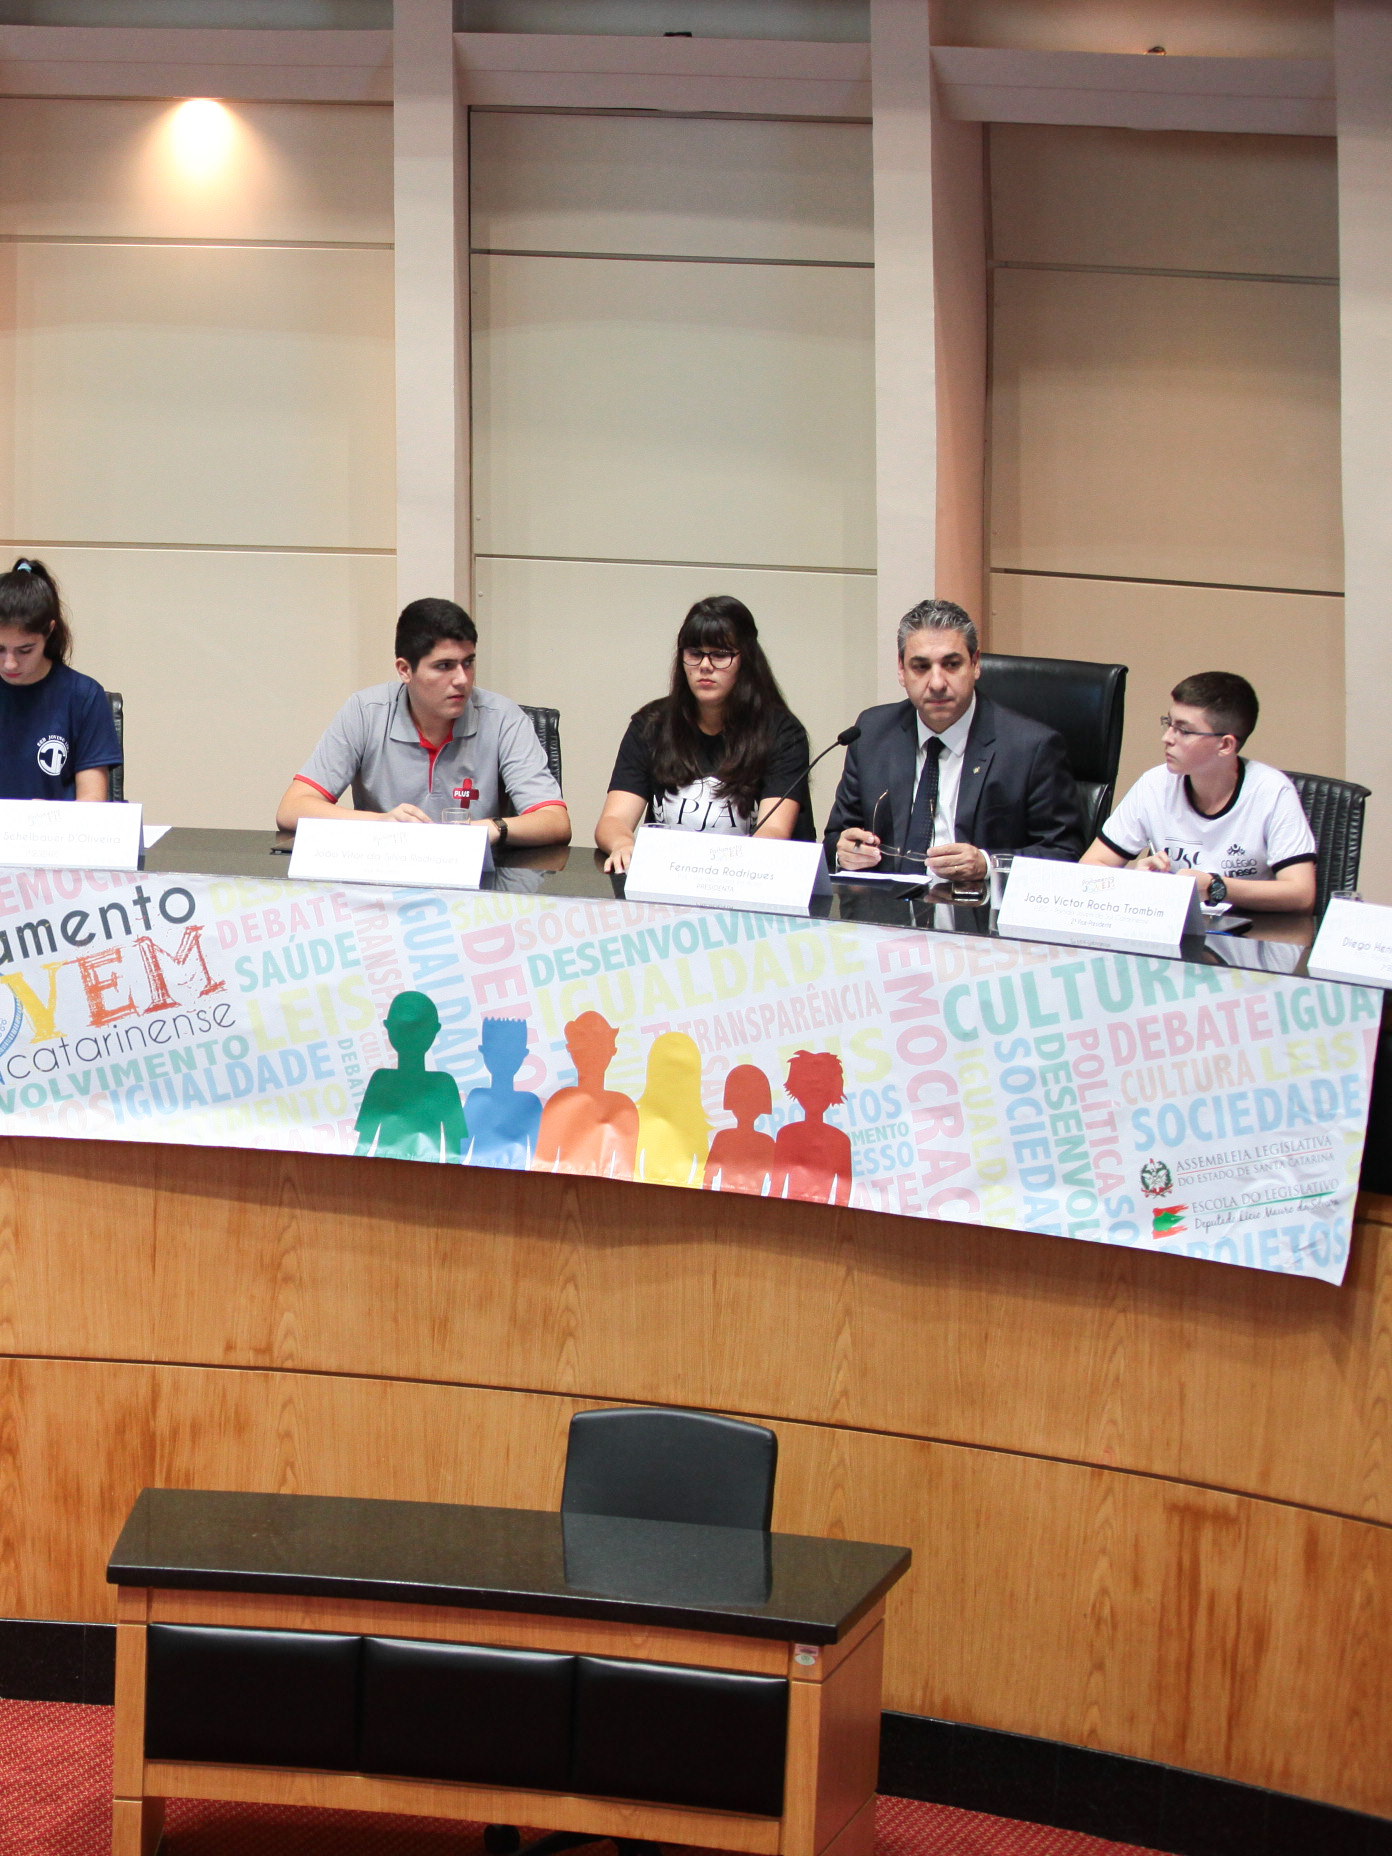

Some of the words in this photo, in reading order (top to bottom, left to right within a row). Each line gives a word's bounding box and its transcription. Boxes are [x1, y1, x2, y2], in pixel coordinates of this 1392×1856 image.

[454, 790, 470, 798] PLUS
[676, 798, 737, 832] PJA
[669, 862, 719, 875] Fernanda
[722, 866, 774, 881] Rodrigues
[696, 883, 734, 892] PRESIDENTA
[215, 891, 352, 950] DEBATE
[1024, 892, 1050, 905] João
[1054, 896, 1083, 909] Victor
[1087, 900, 1119, 913] Rocha
[1124, 904, 1164, 918] Trombim
[235, 931, 362, 993] SAÚDE
[1342, 937, 1371, 951] Diego
[535, 922, 867, 1038] IGUALDADE
[943, 952, 1225, 1042] CULTURA
[245, 975, 376, 1052] LEIS
[678, 980, 883, 1055] TRANSPARÊNCIA
[1107, 993, 1274, 1068] DEBATE
[1274, 983, 1377, 1035] IGUA
[6, 1002, 236, 1080] catarinense
[1258, 1031, 1358, 1082] LEIS
[108, 1040, 337, 1124] IGUALDADE
[1120, 1049, 1256, 1106] CULTURA
[1067, 1027, 1126, 1197] POLÍTICA
[1131, 1073, 1363, 1152] SOCIEDADE
[852, 1141, 914, 1178] ESSO
[1176, 1150, 1253, 1172] ASSEMBLEIA
[1255, 1134, 1332, 1157] LEGISLATIVA
[1177, 1175, 1195, 1187] DO
[1197, 1170, 1235, 1183] ESTADO
[1237, 1167, 1250, 1177] DE
[1252, 1161, 1285, 1175] SANTA
[1287, 1152, 1335, 1169] CATARINA
[1192, 1197, 1238, 1213] ESCOLA
[1240, 1190, 1262, 1204] DO
[1264, 1178, 1340, 1201] LEGISLATIVO
